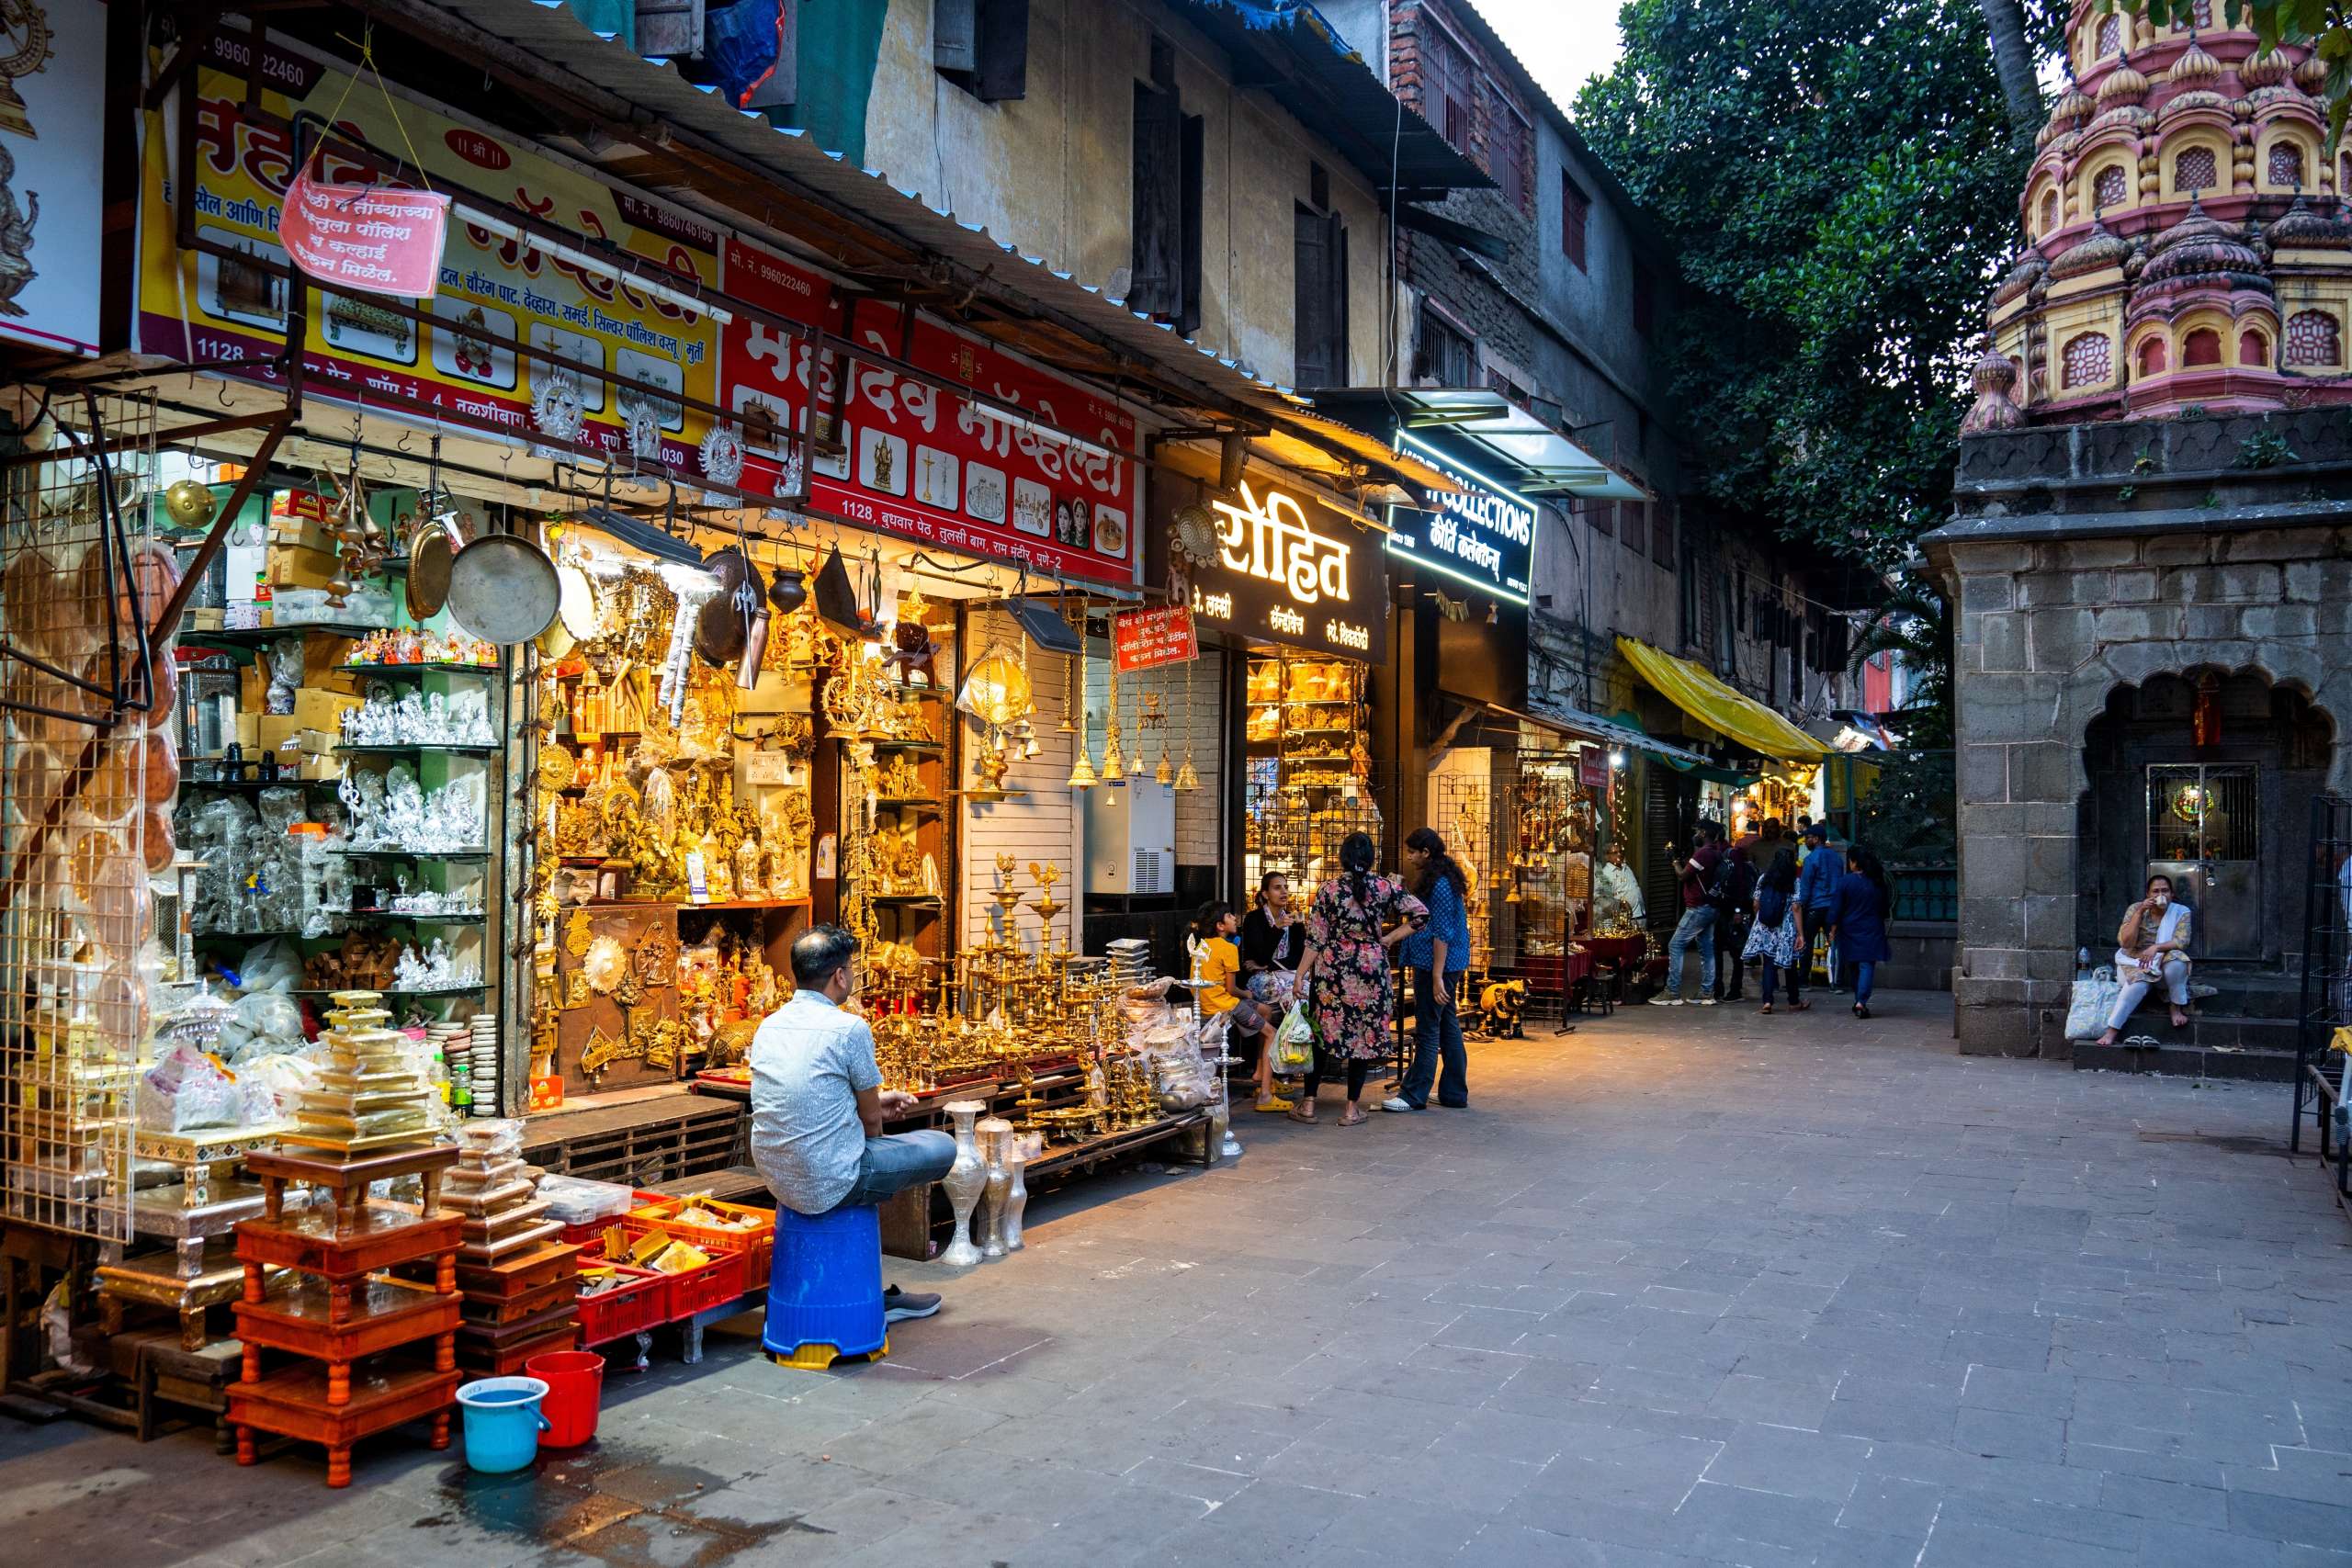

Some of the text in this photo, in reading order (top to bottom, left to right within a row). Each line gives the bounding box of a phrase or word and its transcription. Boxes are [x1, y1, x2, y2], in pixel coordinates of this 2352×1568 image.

[214, 38, 304, 87] 996022460
[472, 143, 486, 159] श्री
[356, 220, 412, 241] पॉलिश
[657, 209, 713, 243] 9860746166
[329, 239, 389, 262] कल्हाई
[226, 198, 264, 229] आणि
[465, 269, 496, 298] चौरंग
[499, 283, 521, 306] पाट,
[524, 288, 560, 320] देव्हारा,
[562, 303, 591, 329] समई,
[594, 309, 624, 338] सिल्वर
[627, 320, 656, 347] पॉलिश
[341, 260, 398, 282] मिळेल.
[761, 264, 810, 297] 9960222460
[1442, 470, 1531, 547] COLLECTIONS
[842, 500, 876, 525] 1128,
[881, 512, 914, 530] बुधवार
[917, 517, 935, 539] पेठ,
[939, 526, 967, 545] तुलसी
[969, 536, 989, 553] बाग,
[993, 541, 1008, 555] राम
[1212, 479, 1351, 604] रोहित
